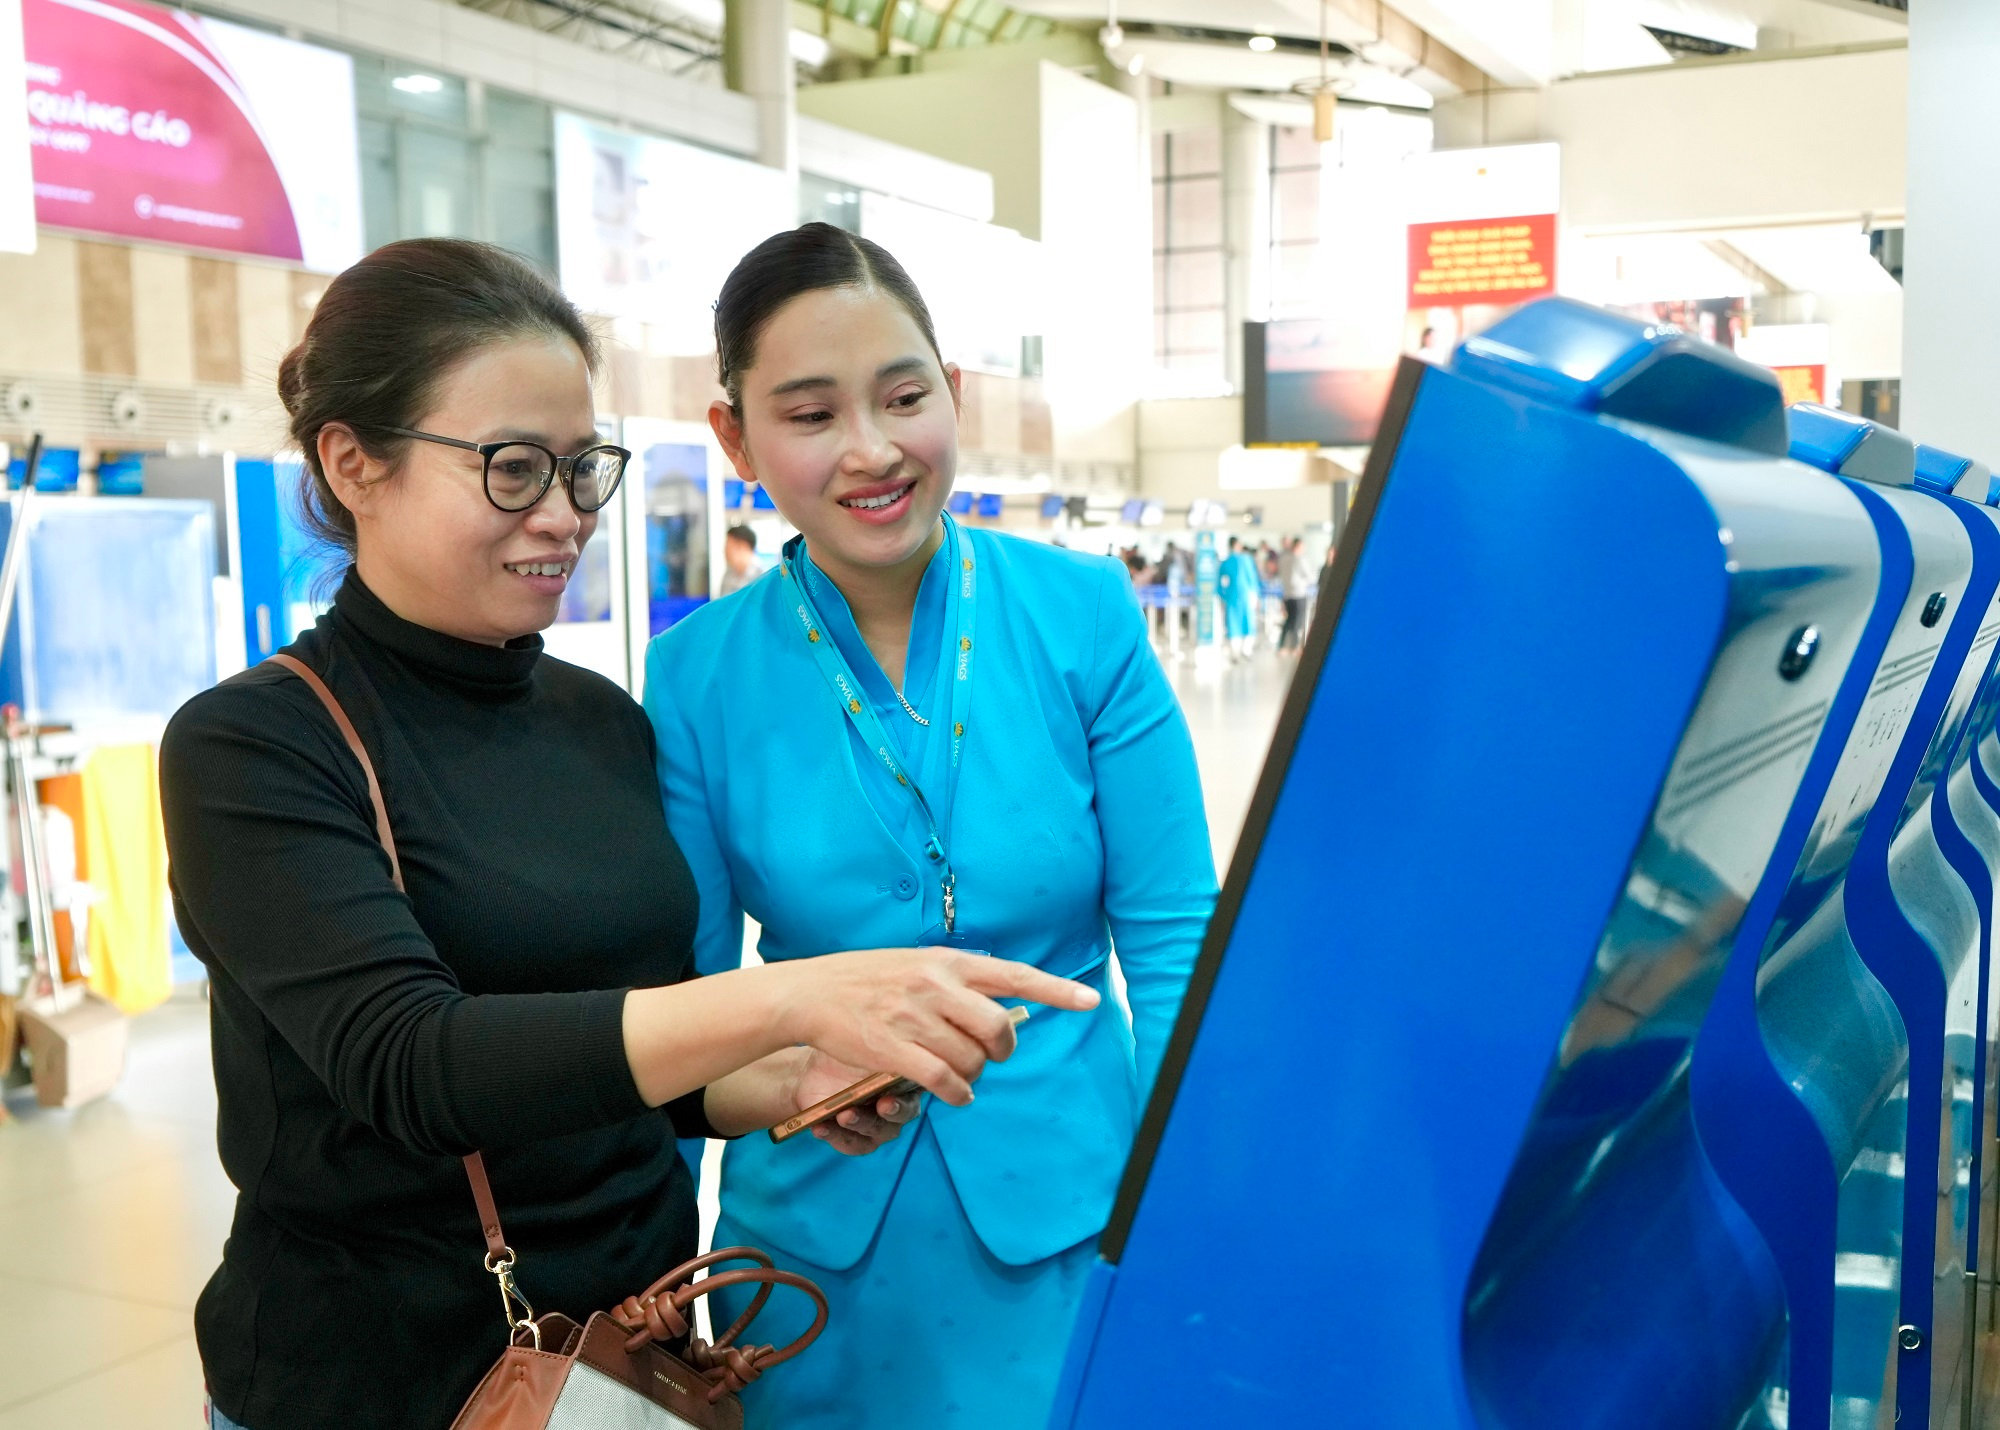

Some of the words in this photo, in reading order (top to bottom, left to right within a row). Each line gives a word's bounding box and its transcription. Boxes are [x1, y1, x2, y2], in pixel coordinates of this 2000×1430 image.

[963, 571, 971, 598] VIAGS
[796, 603, 813, 631] VIAGS
[959, 652, 967, 680] VIAGS
[835, 673, 854, 701] VIAGS
[879, 747, 896, 774] VIAGS
